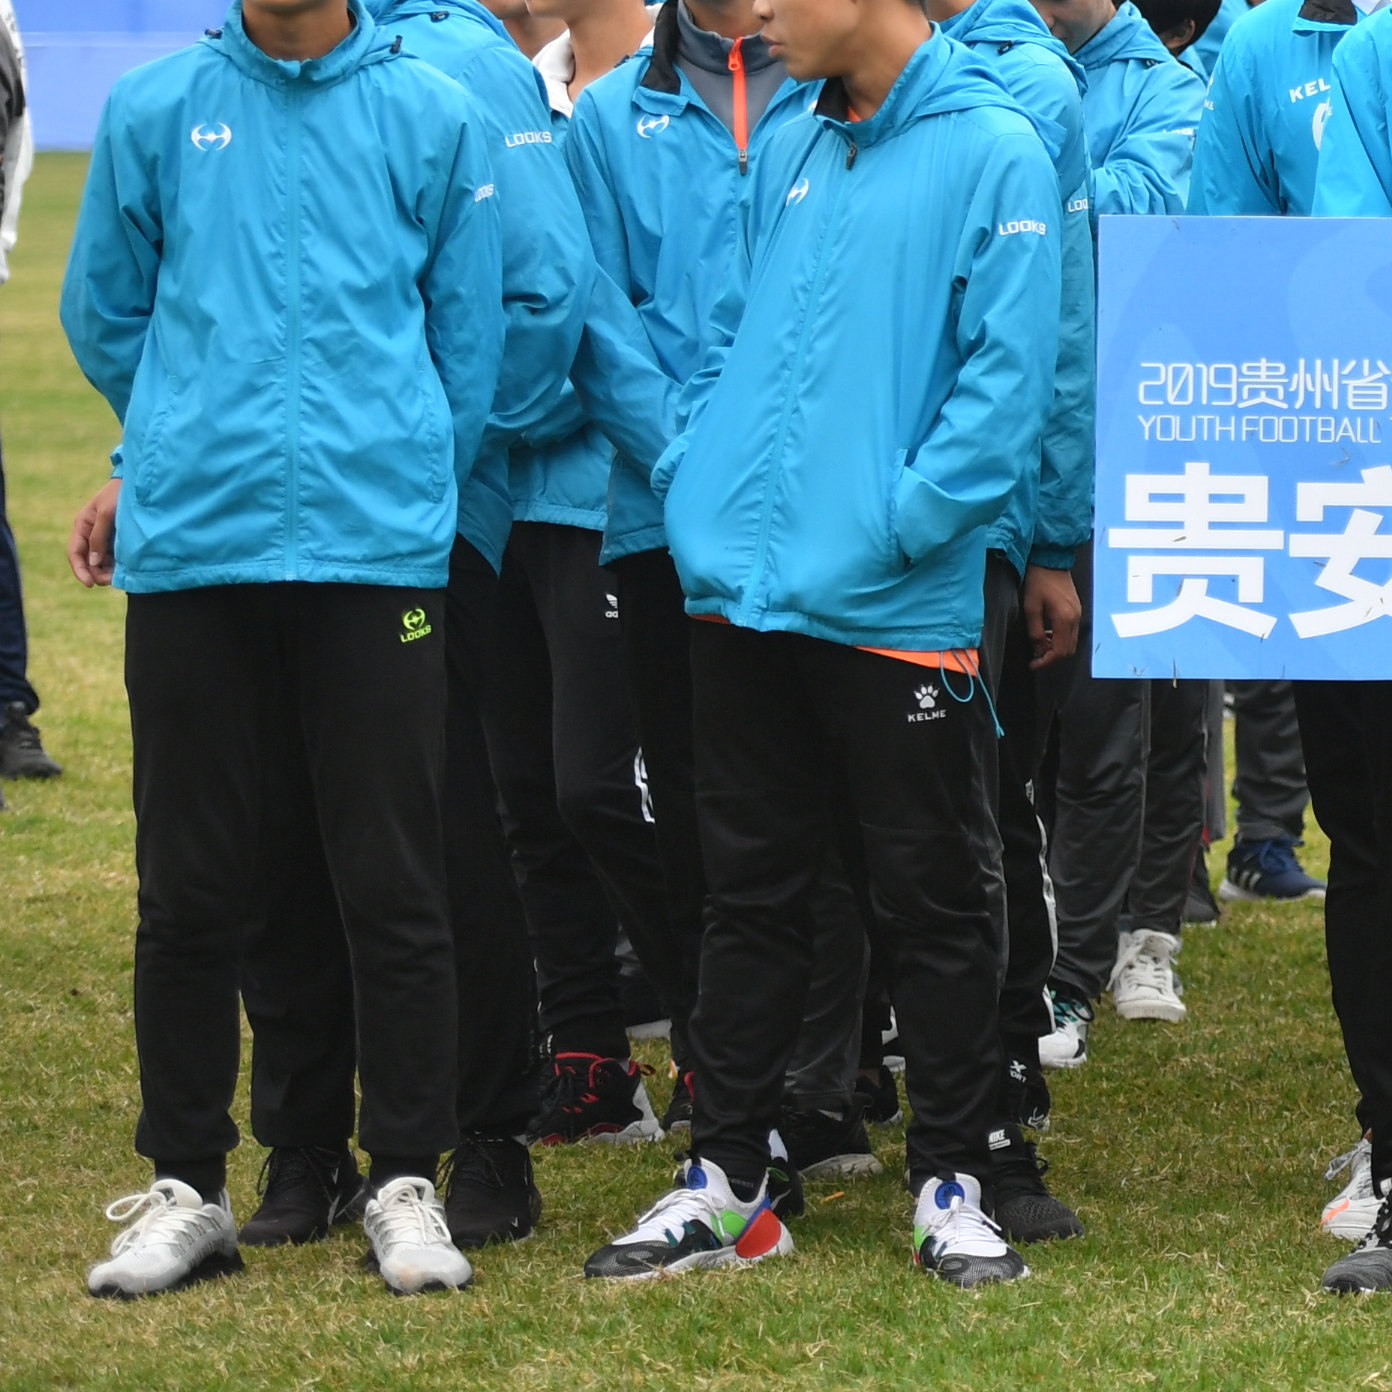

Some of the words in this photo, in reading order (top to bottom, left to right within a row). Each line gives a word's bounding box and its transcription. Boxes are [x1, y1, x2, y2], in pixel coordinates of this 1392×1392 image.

[1288, 78, 1331, 104] KEL
[504, 131, 553, 148] LOOKS
[998, 219, 1047, 236] LOOKS
[1137, 414, 1236, 443] YOUTH
[1242, 416, 1383, 444] FOOTBALL
[400, 624, 432, 643] LOOKS
[907, 709, 947, 723] KELME
